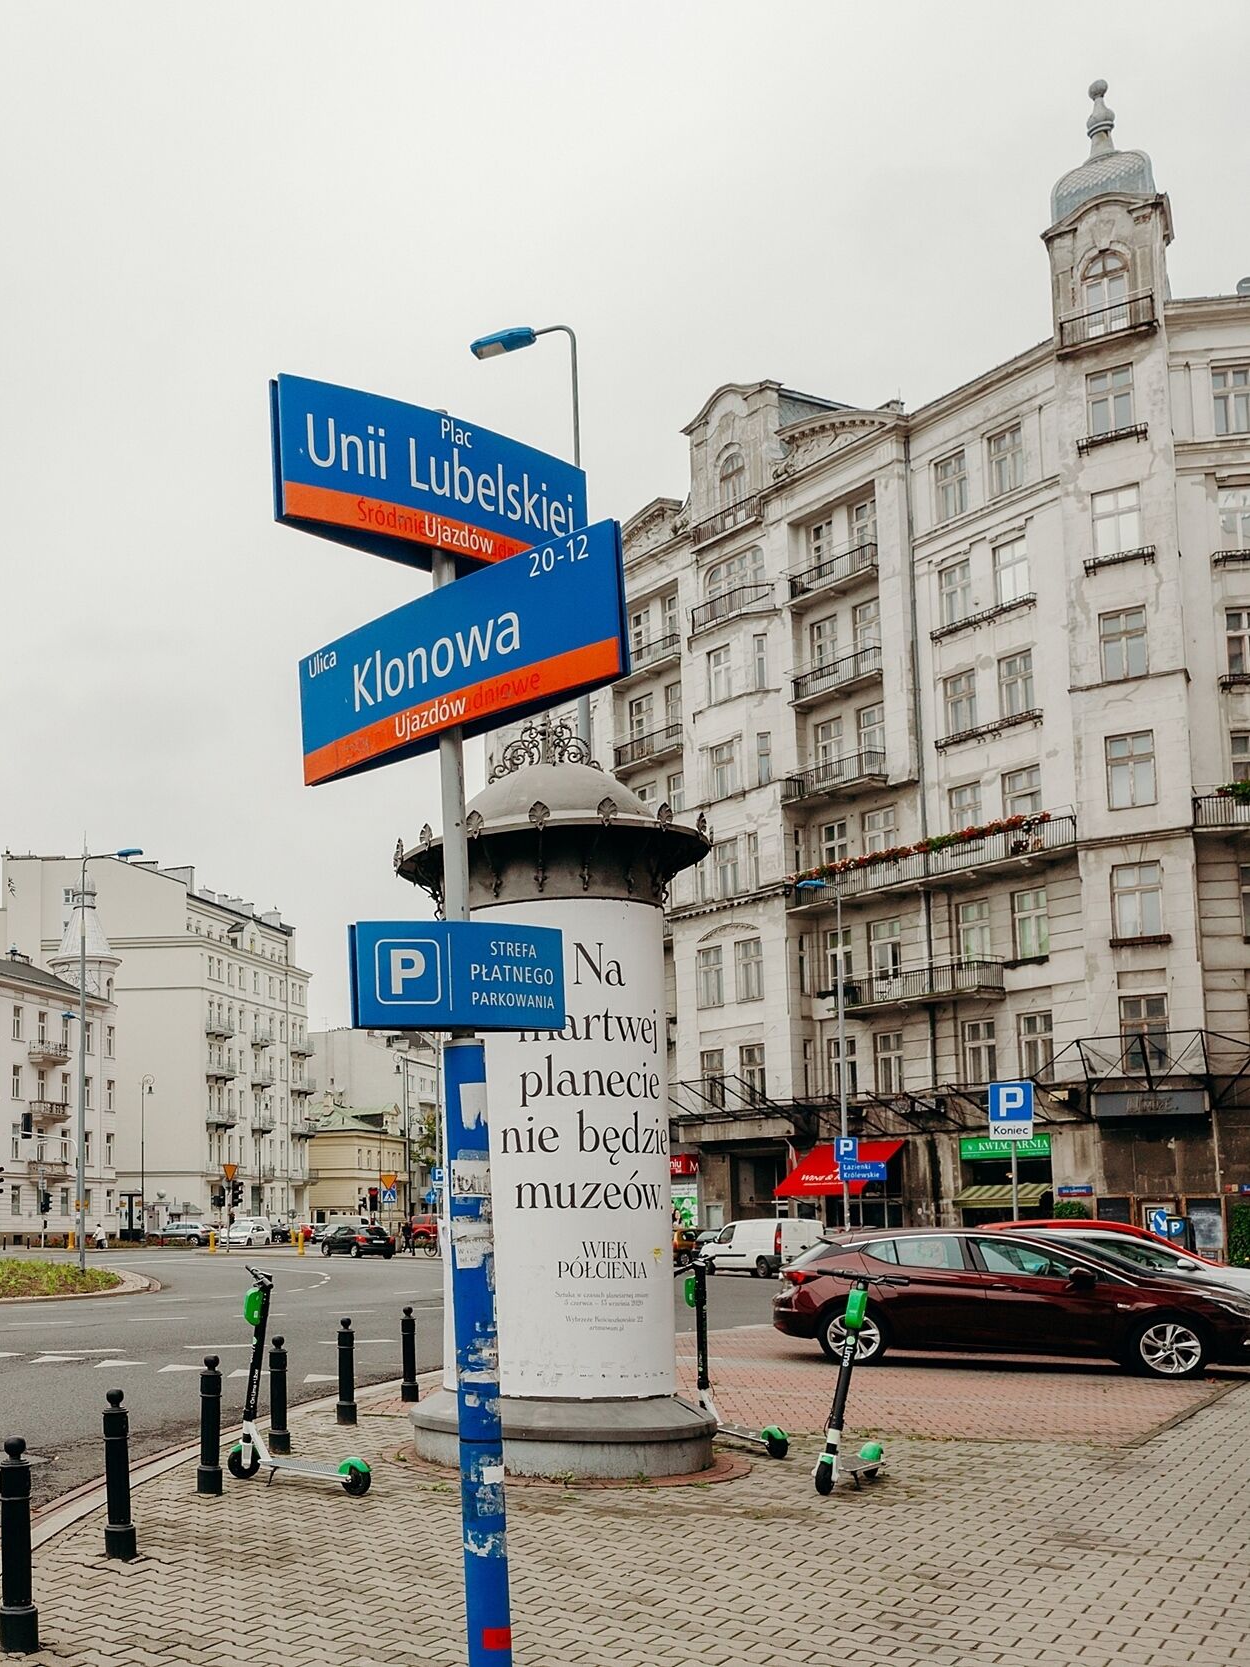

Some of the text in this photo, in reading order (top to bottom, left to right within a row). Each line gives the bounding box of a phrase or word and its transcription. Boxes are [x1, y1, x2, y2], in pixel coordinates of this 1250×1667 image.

[440, 418, 473, 448] Plac
[306, 412, 574, 538] Unii Lubelskiej
[424, 514, 494, 554] Ujazdów
[529, 534, 590, 578] 20-12
[308, 649, 338, 679] Ulica
[352, 610, 521, 712] Klonowa
[395, 696, 467, 741] Ujazdów
[490, 941, 538, 959] STREFA
[573, 942, 626, 987] Na
[390, 948, 426, 994] P
[470, 962, 554, 986] PŁATNEGO
[472, 992, 555, 1010] PARKOWANIA
[520, 1055, 660, 1108] planecie
[1000, 1087, 1024, 1117] P
[501, 1110, 668, 1166] nie będzie
[978, 1139, 1048, 1151] KWIACARNIA
[993, 1125, 1029, 1136] Koniec
[840, 1140, 854, 1156] P
[843, 1163, 871, 1171] Łazienki
[515, 1170, 664, 1211] muzeów.
[582, 1241, 628, 1258] WIEK
[558, 1256, 648, 1278] PÓŁCIENIA
